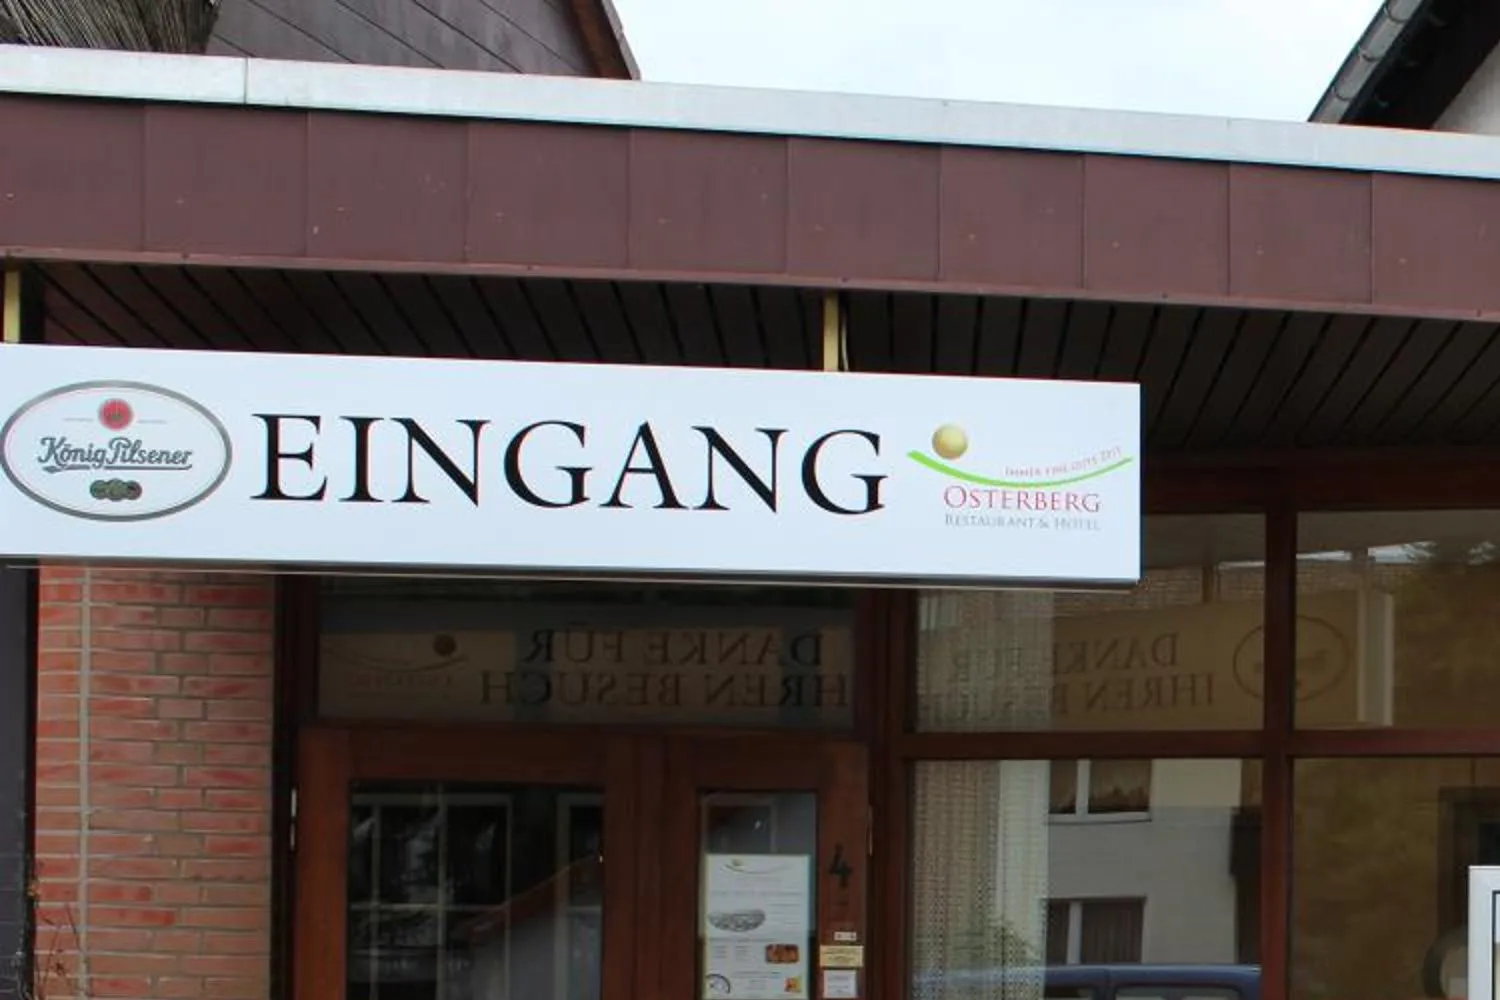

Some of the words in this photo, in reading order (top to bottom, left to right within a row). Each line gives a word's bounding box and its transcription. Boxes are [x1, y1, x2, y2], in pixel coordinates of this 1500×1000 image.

[37, 436, 108, 472] König
[104, 436, 193, 467] Pilsener
[251, 412, 888, 516] EINGANG
[943, 484, 1102, 514] OSTERBERG
[828, 844, 854, 890] 4
